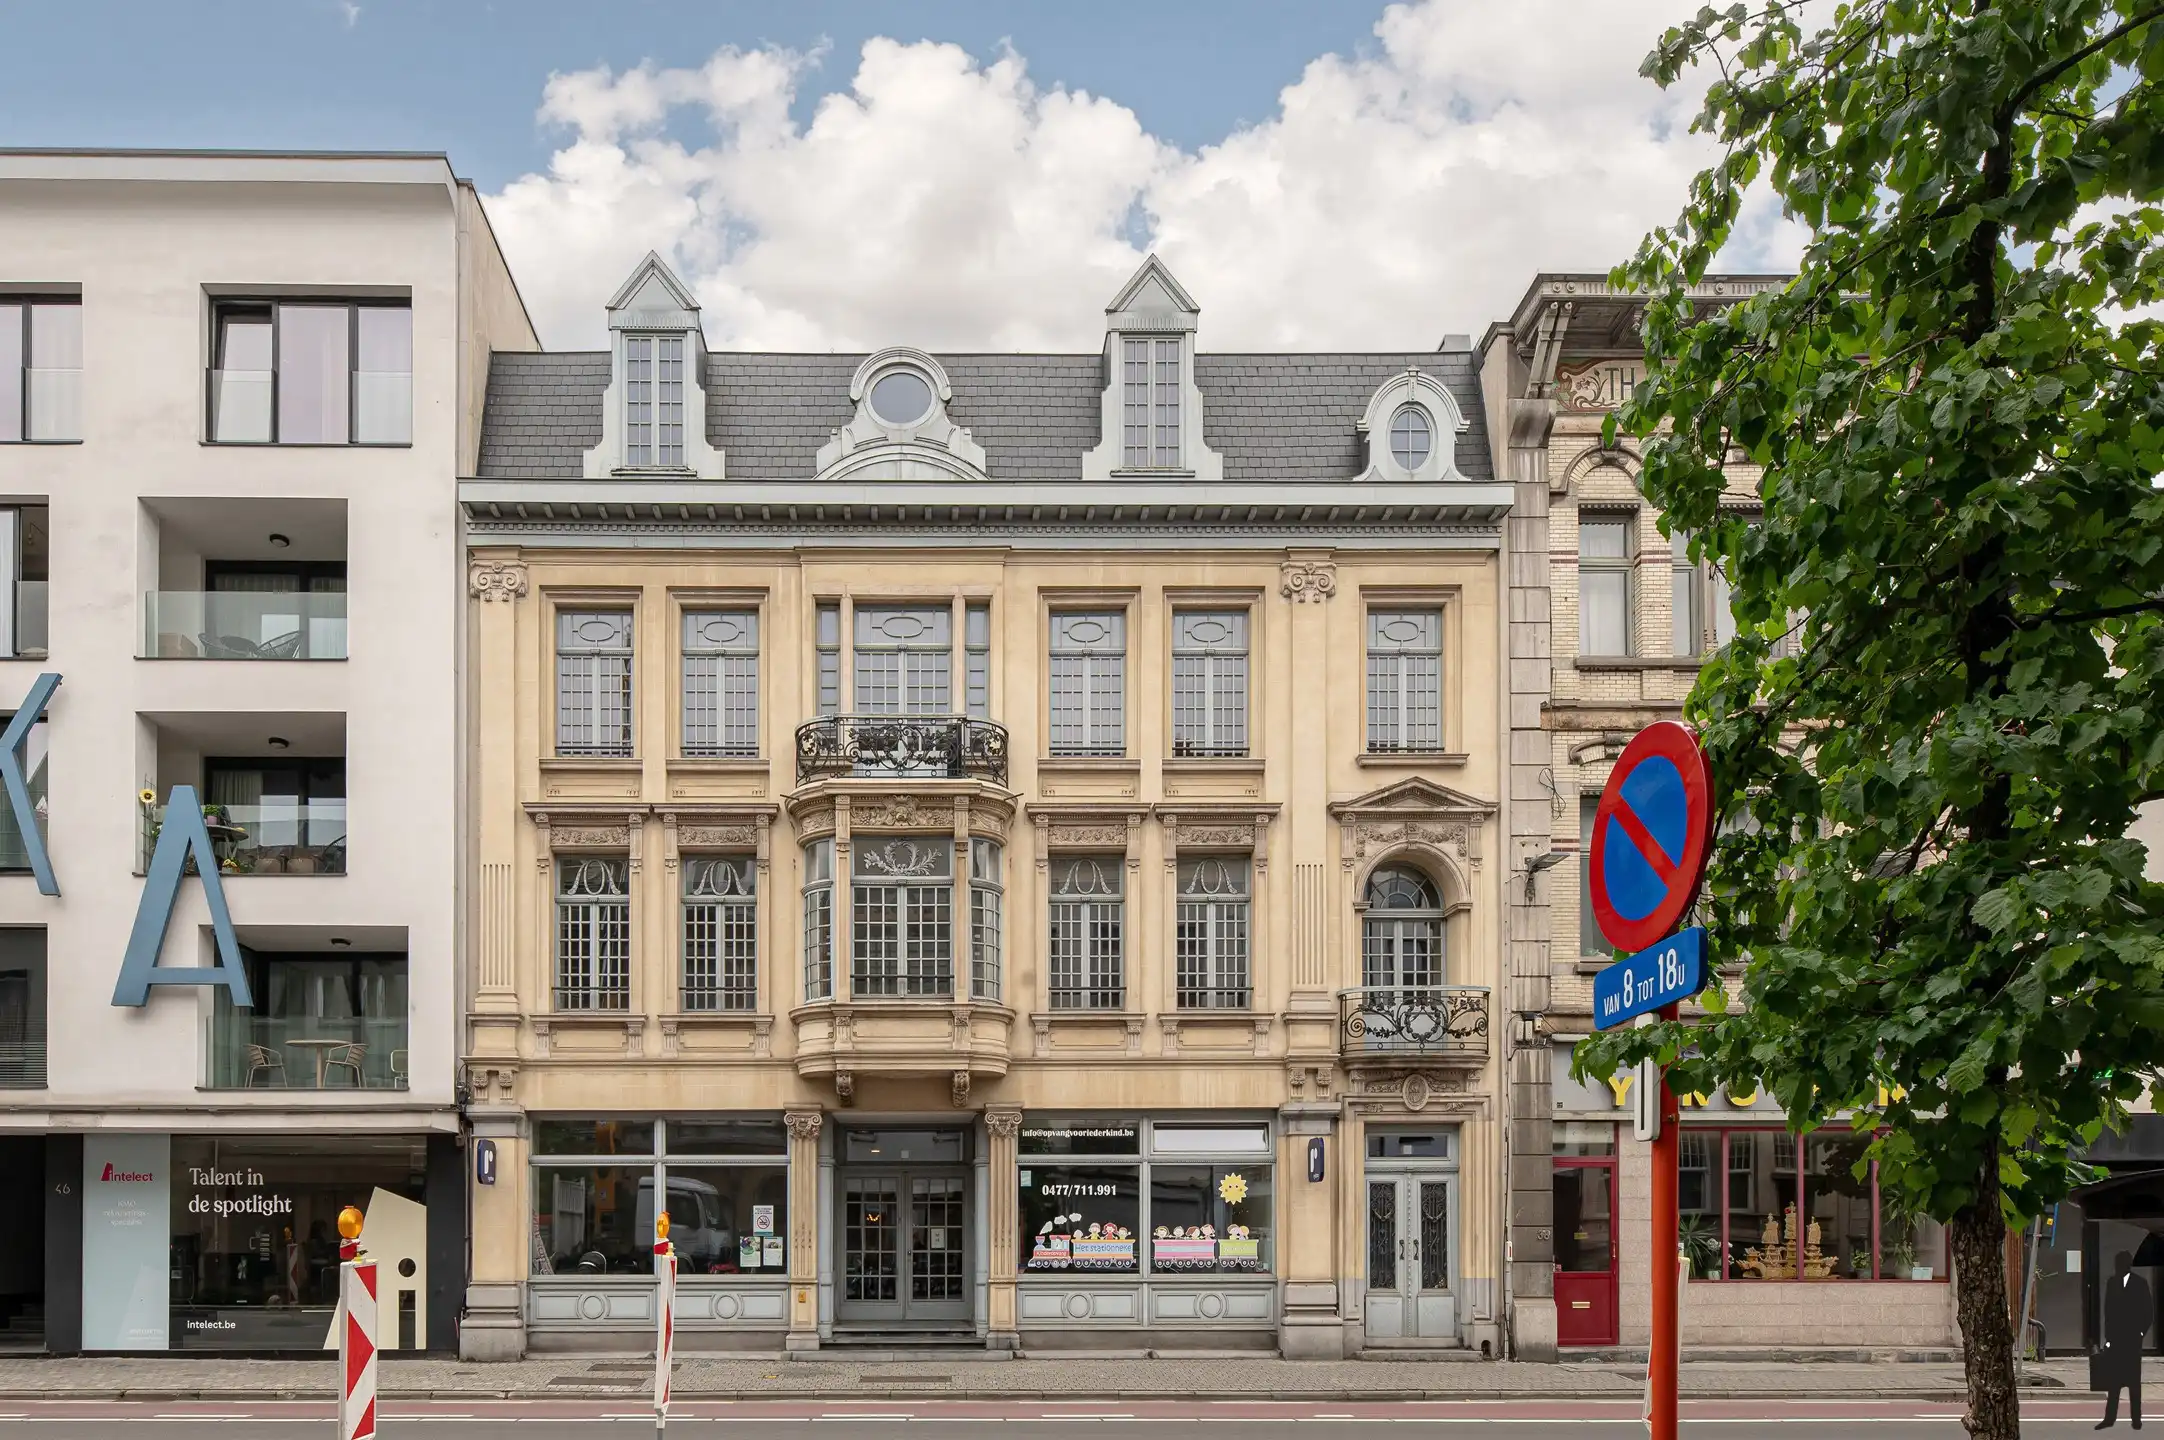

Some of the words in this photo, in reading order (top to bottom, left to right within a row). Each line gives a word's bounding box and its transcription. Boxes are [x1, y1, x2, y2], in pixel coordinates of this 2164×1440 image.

[1603, 992, 1620, 1017] VAN
[1624, 968, 1633, 1008] 8
[1637, 976, 1655, 1003] TOT
[188, 1167, 243, 1186] Talent
[247, 1167, 264, 1186] in
[55, 1182, 71, 1195] 46
[1041, 1184, 1117, 1198] 0477/711.991
[188, 1194, 210, 1213] de
[213, 1194, 292, 1218] spotlight
[1537, 1229, 1551, 1240] 38
[186, 1320, 236, 1330] intelect.be
